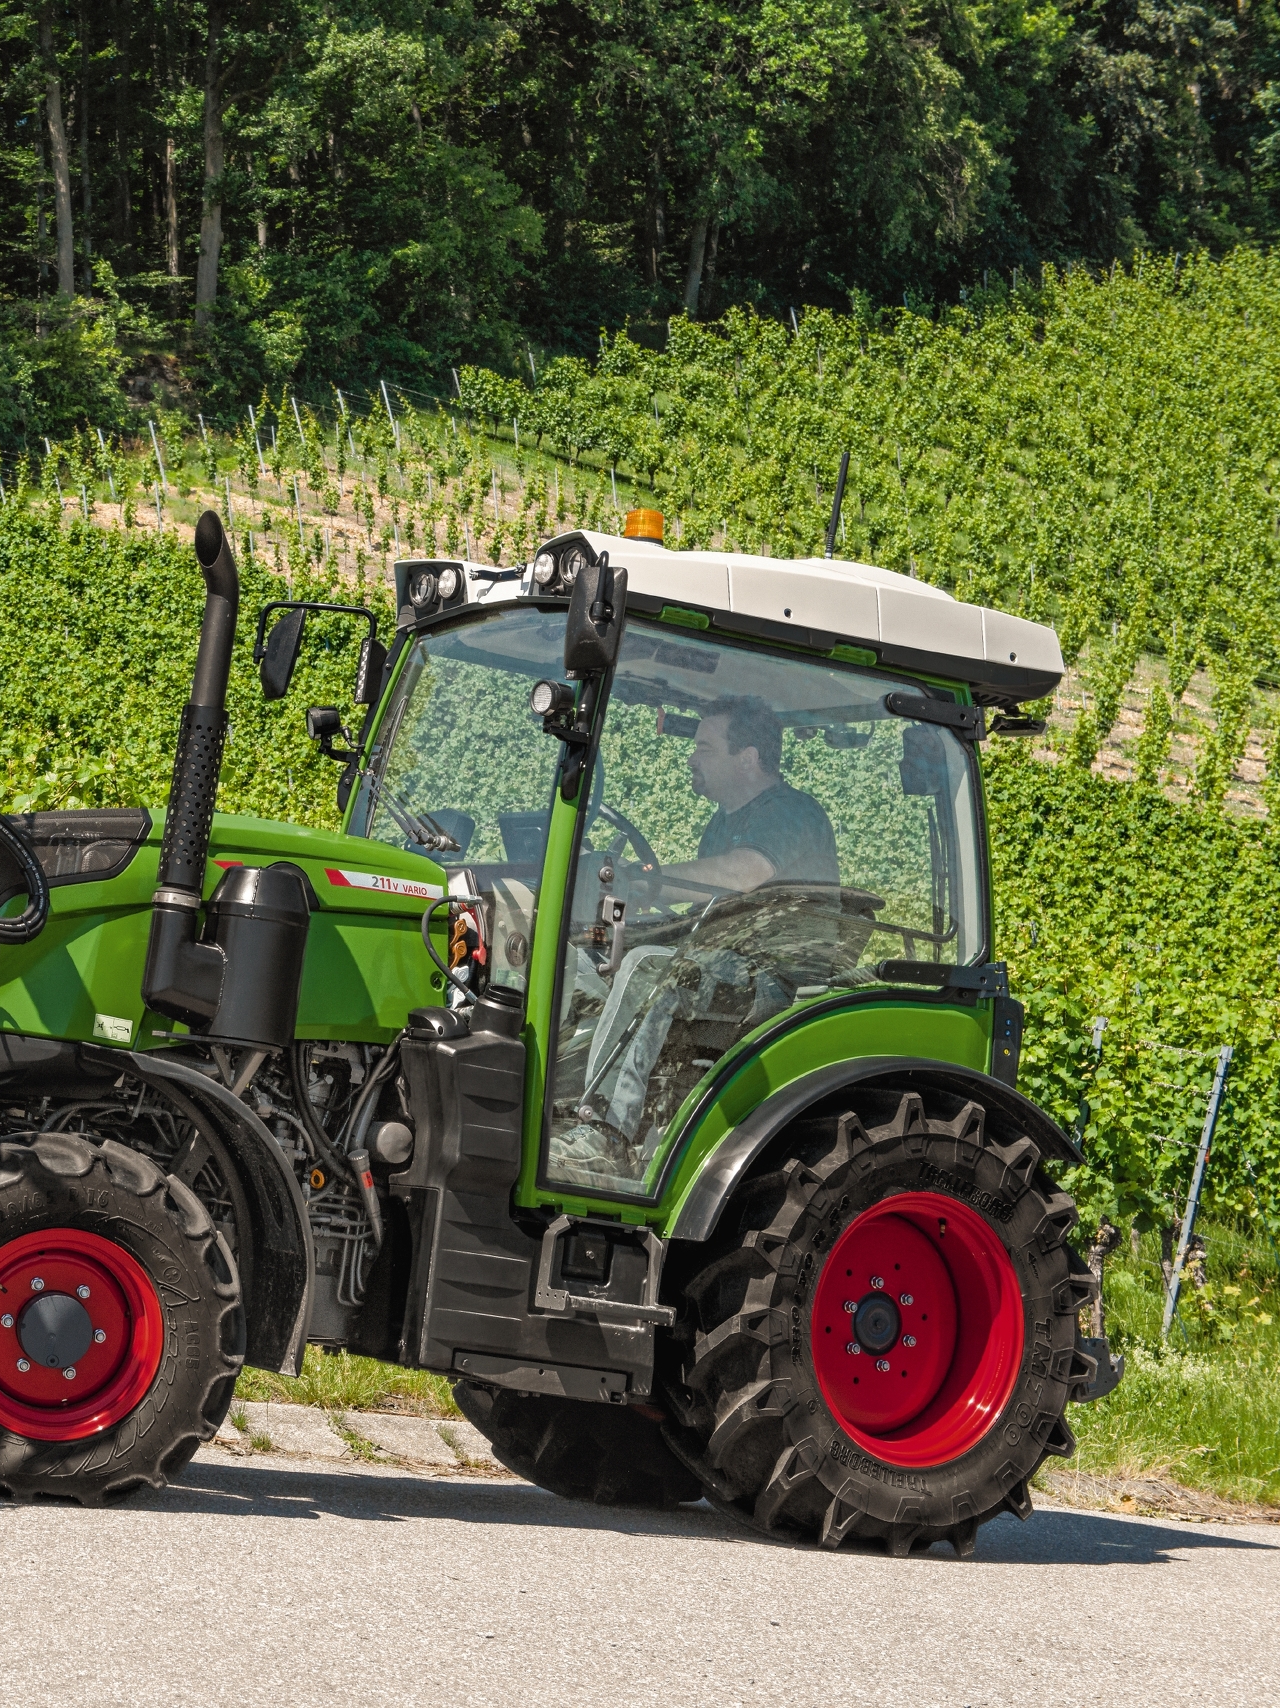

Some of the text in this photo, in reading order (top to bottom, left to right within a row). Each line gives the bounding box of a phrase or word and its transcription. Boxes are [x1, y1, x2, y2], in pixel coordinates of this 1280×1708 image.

[402, 884, 428, 896] VARIO
[919, 1161, 1015, 1223] TRELLEBORG
[1003, 1316, 1053, 1447] TM700
[828, 1440, 935, 1498] TRELLEBORG
